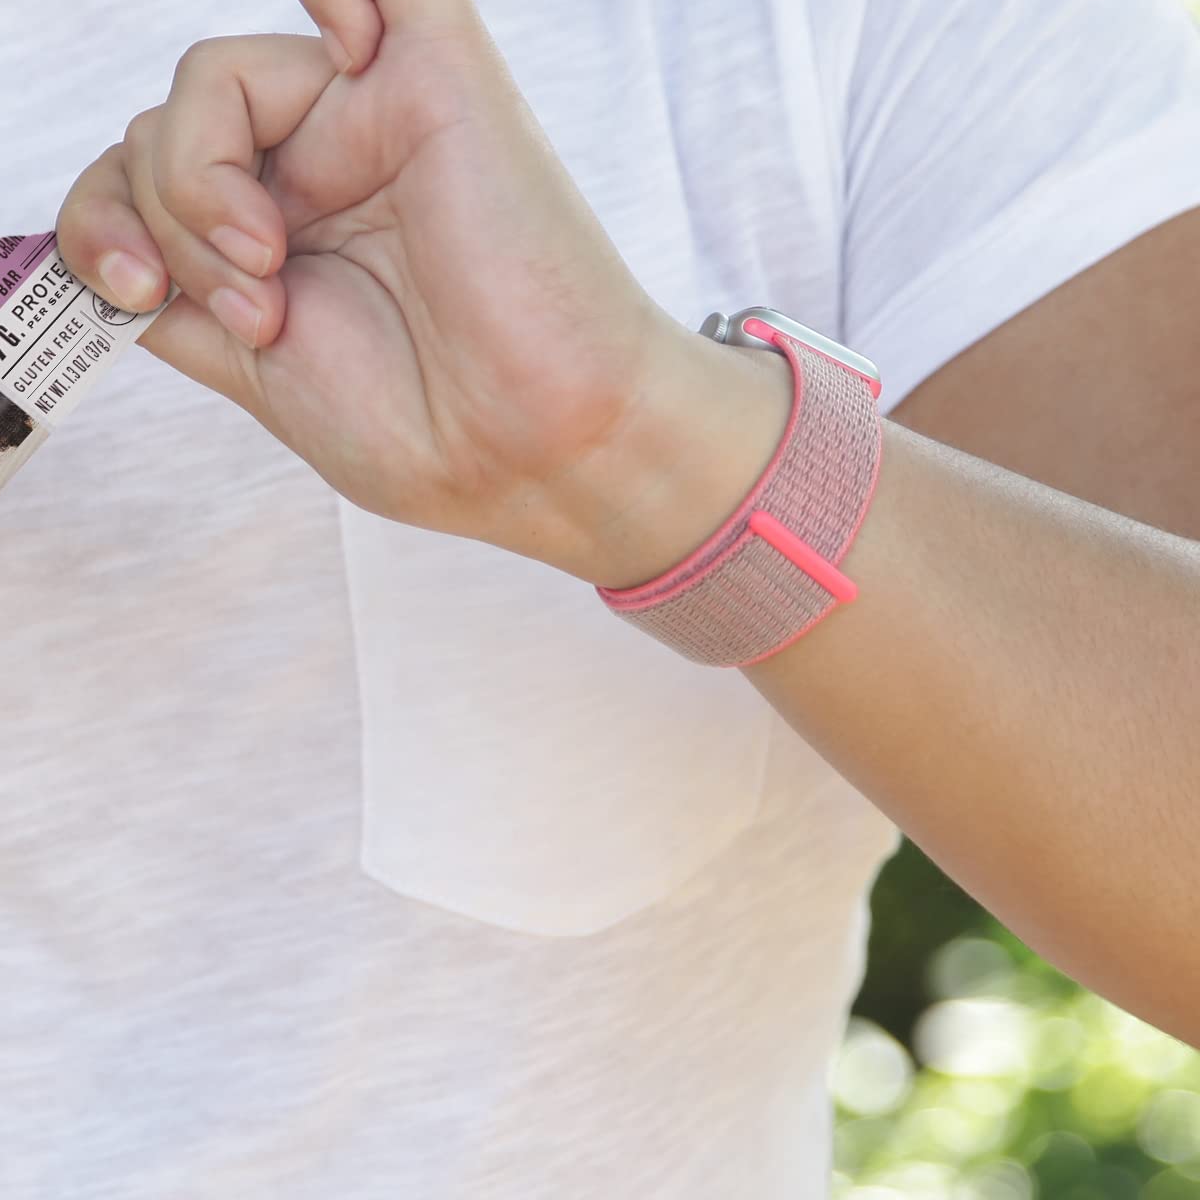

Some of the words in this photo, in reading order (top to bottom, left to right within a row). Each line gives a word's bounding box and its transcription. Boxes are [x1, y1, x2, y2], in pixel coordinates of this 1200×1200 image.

[13, 347, 56, 393] GLUTEN
[52, 317, 84, 349] FREE
[27, 307, 48, 329] PER
[34, 392, 56, 414] NET
[50, 378, 71, 398] WT.
[62, 366, 81, 384] 1.3
[72, 355, 91, 372] OZ
[82, 333, 111, 362] (37g)
